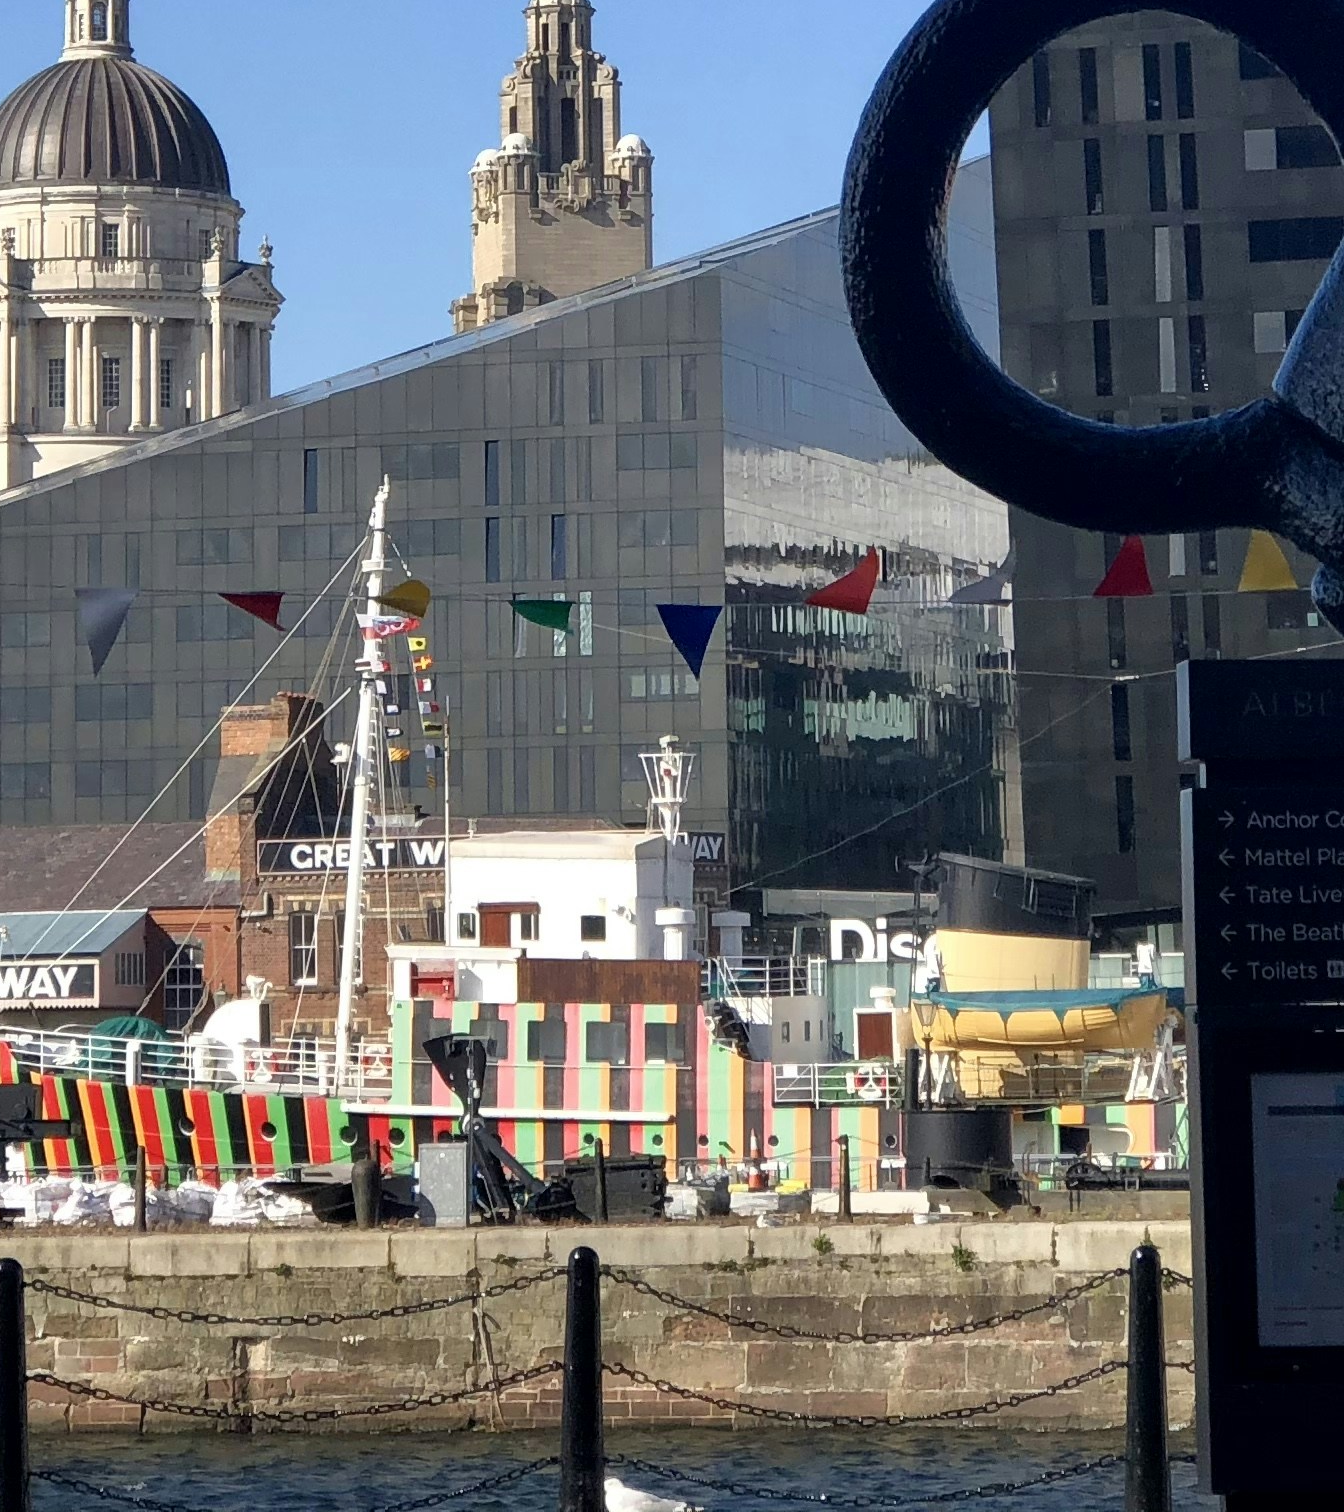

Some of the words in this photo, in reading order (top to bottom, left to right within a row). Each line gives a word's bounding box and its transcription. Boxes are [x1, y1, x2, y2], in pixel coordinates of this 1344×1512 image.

[1247, 810, 1320, 829] Anchor
[290, 842, 395, 869] GREAT
[1245, 847, 1311, 866] Mattel
[1246, 885, 1293, 904] Tate
[1246, 923, 1286, 942] The
[1247, 961, 1318, 981] Toilets
